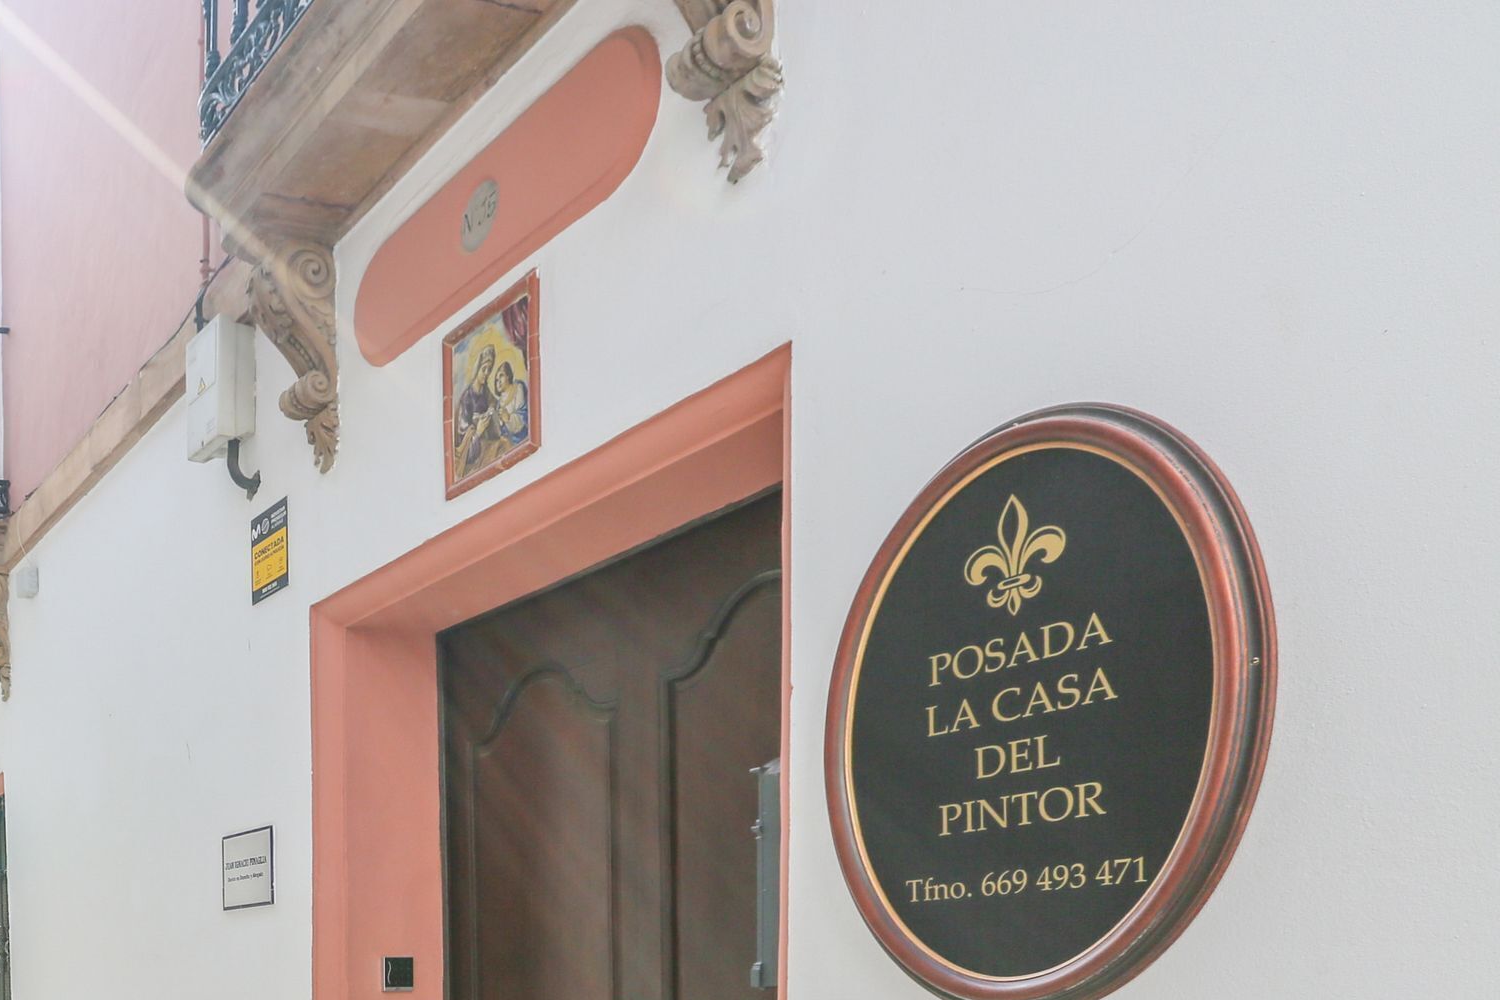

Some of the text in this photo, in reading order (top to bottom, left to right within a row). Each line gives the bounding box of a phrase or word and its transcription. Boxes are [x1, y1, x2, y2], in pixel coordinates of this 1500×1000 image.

[254, 536, 285, 560] CONECTADA
[928, 612, 1113, 687] POSADA
[926, 667, 1118, 737] LA CASA
[974, 735, 1061, 780] DEL
[938, 781, 1107, 837] PINTOR
[905, 855, 1149, 903] Tfno. 669 493 471
